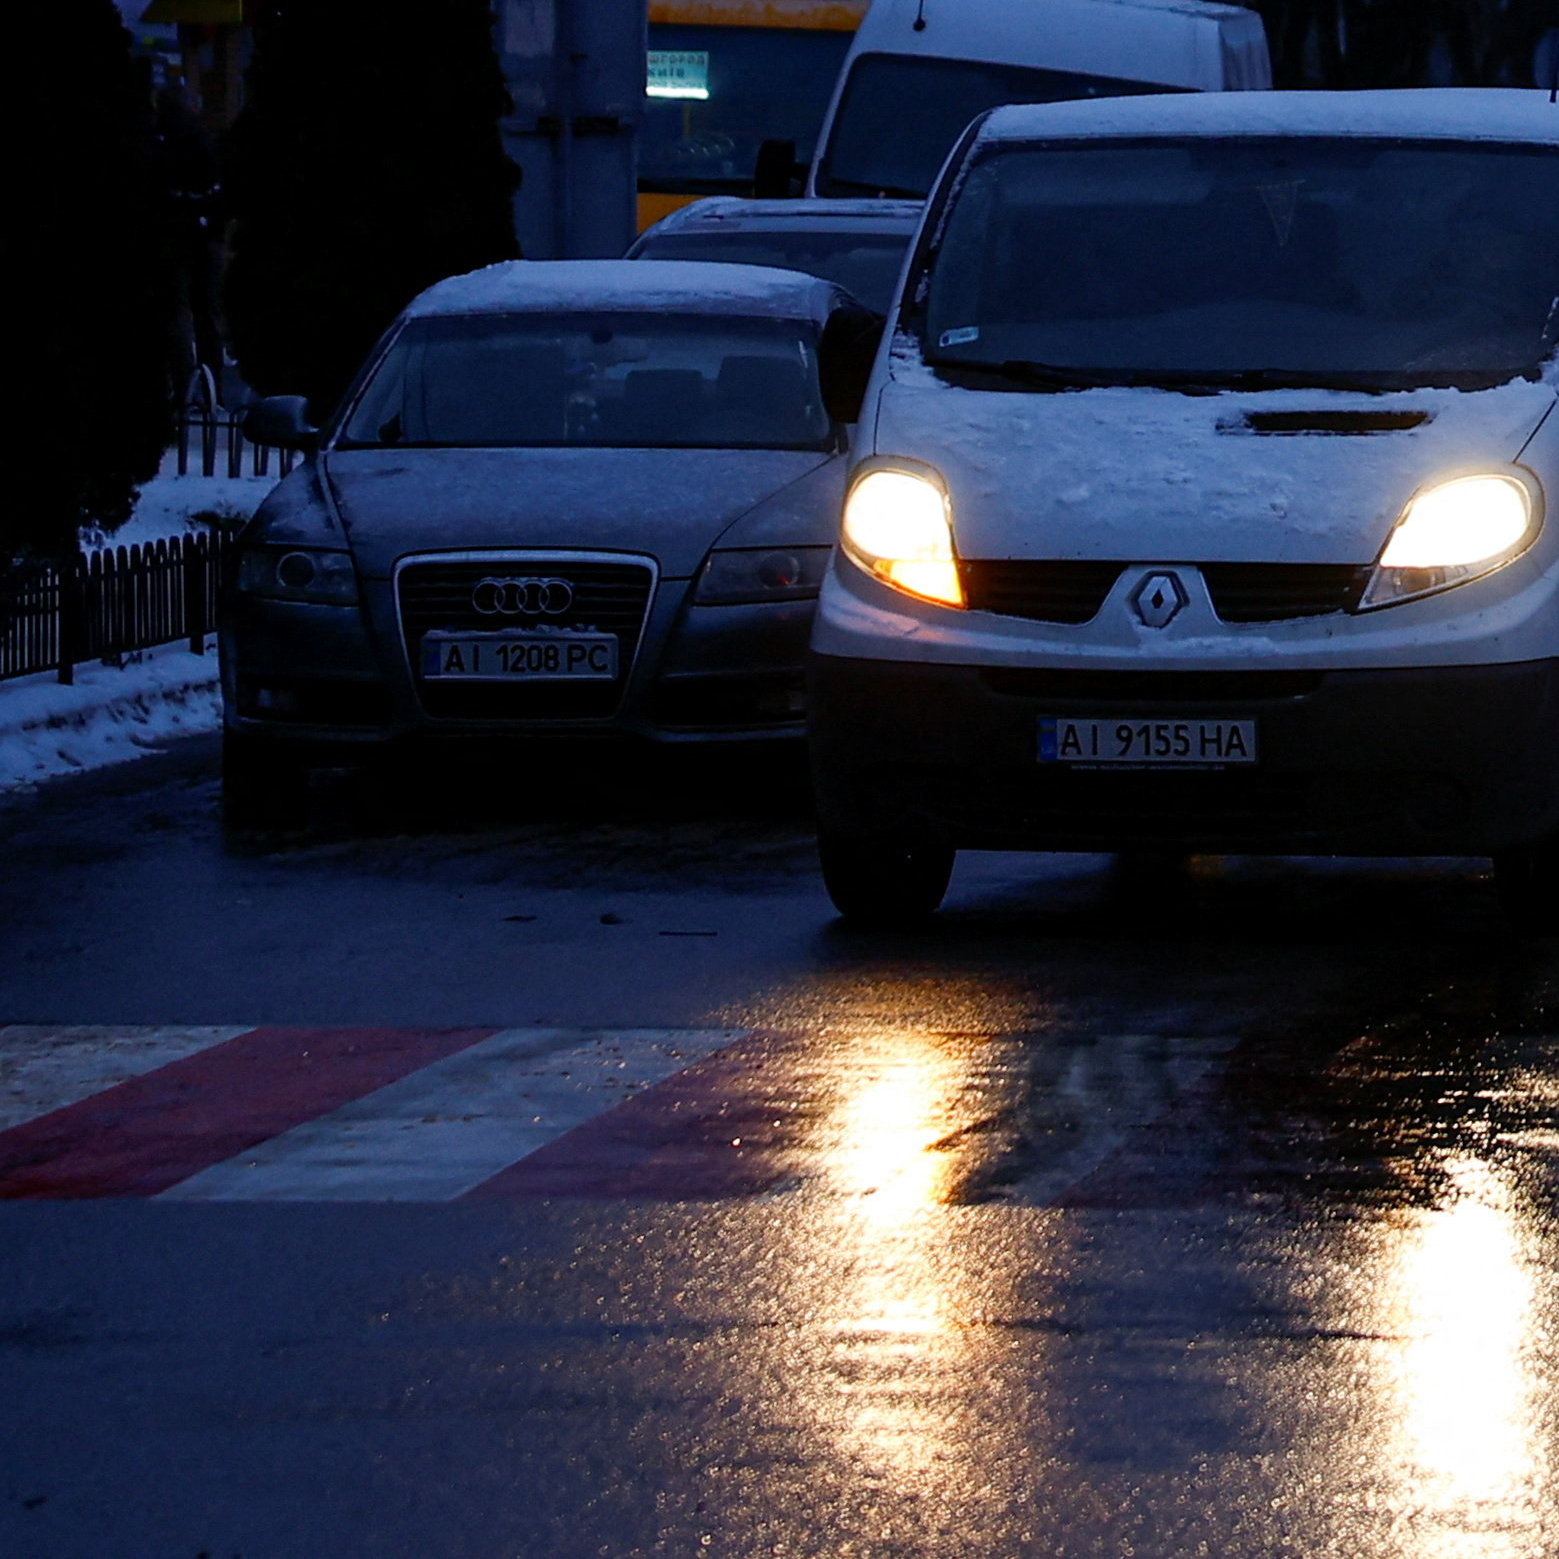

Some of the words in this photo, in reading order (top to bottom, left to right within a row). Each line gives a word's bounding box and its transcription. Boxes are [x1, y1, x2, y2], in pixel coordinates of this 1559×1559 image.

[444, 644, 479, 672] AI
[495, 644, 560, 672] 1208
[567, 644, 609, 672] PC
[1060, 724, 1098, 756] AI
[1116, 724, 1191, 757] 9155
[1199, 724, 1247, 757] HA
